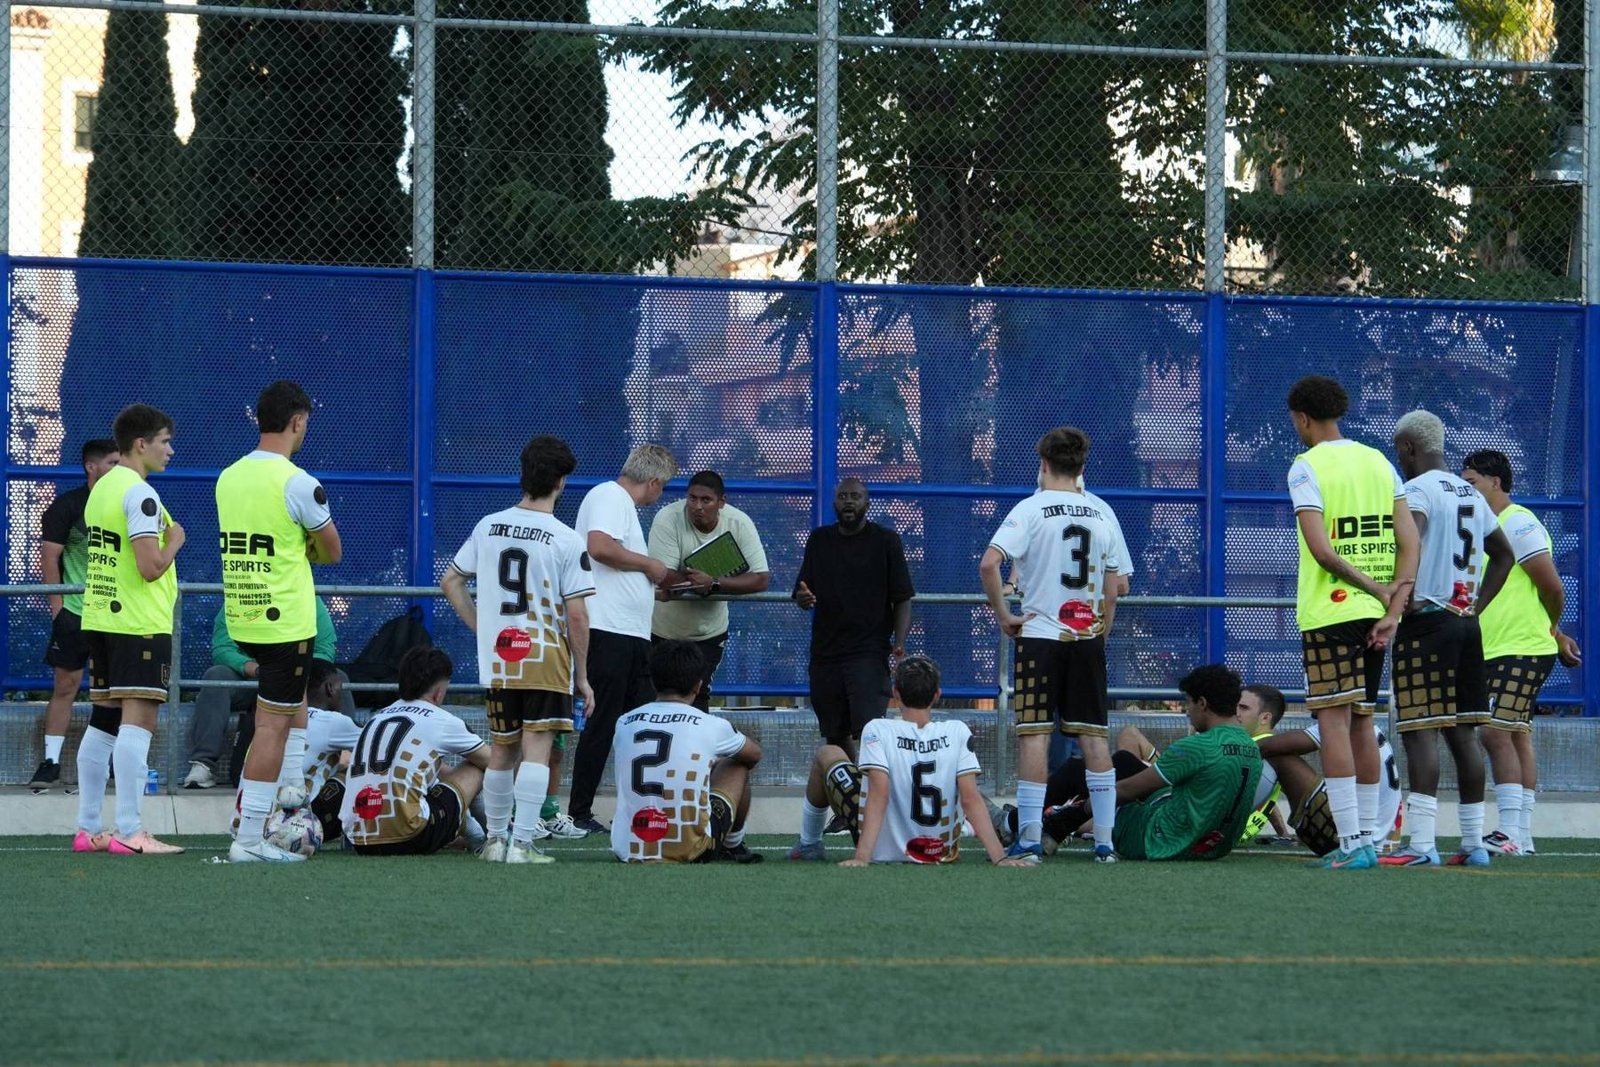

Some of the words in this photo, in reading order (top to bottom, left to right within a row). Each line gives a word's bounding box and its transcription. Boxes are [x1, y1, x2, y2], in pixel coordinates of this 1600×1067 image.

[540, 530, 554, 545] FC
[1060, 523, 1091, 590] 3
[1453, 504, 1474, 571] 5
[498, 546, 529, 616] 9
[417, 707, 434, 718] FC
[686, 714, 702, 726] FC
[350, 715, 416, 779] 10
[631, 728, 674, 798] 2
[911, 760, 942, 827] 6
[1222, 766, 1251, 824] 1
